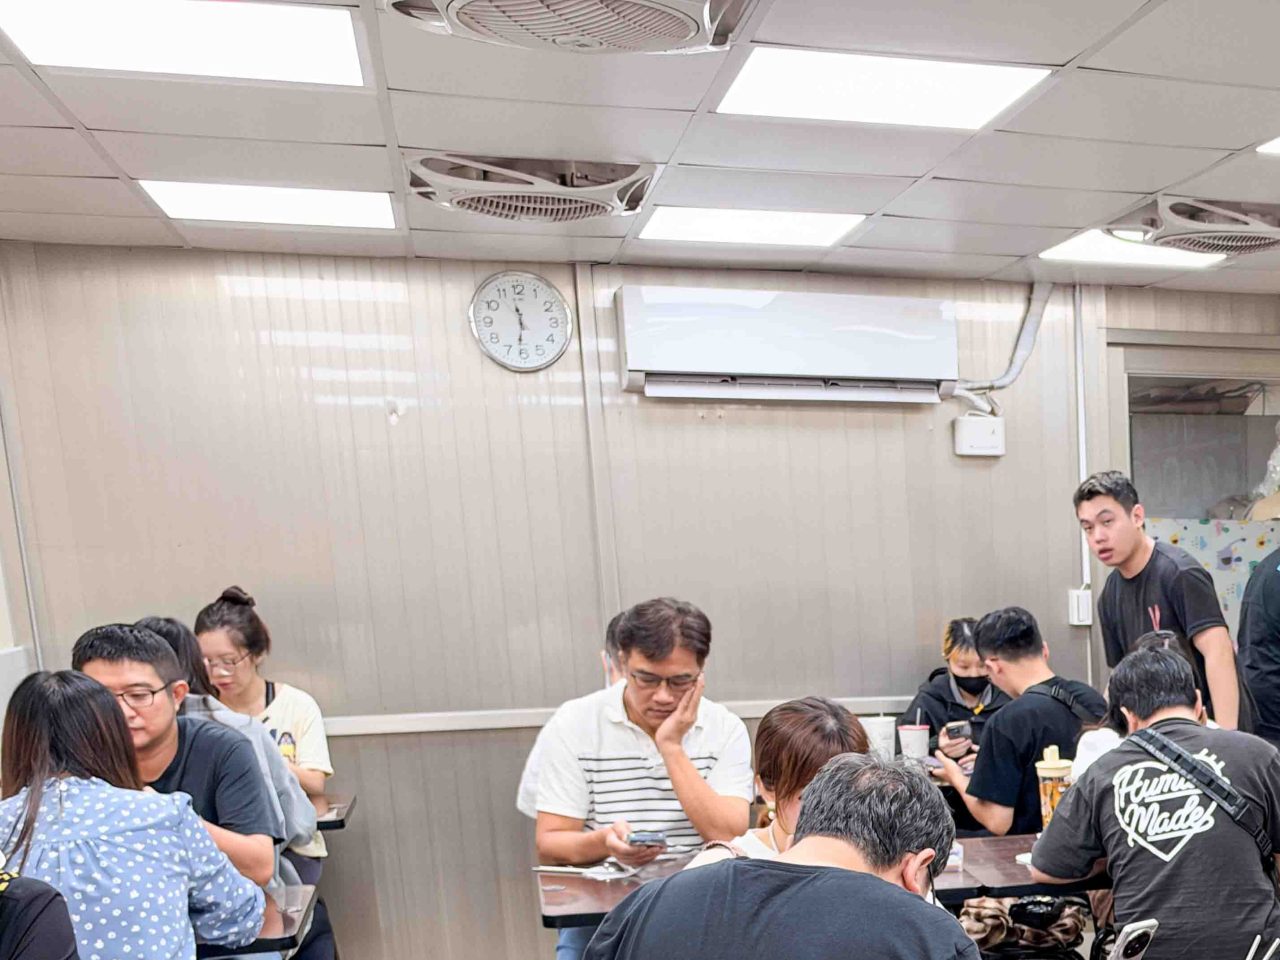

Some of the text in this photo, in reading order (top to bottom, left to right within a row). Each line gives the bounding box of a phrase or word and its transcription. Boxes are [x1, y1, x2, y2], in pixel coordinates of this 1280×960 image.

[497, 288, 507, 298] 11
[512, 285, 525, 295] 12
[486, 300, 500, 311] 10
[543, 301, 553, 312] 2
[482, 316, 493, 327] 9
[549, 317, 559, 328] 3
[490, 333, 499, 344] 8
[545, 334, 555, 344] 4
[504, 345, 512, 355] 7
[519, 349, 529, 360] 6
[536, 345, 545, 356] 5
[1124, 795, 1210, 843] Made
